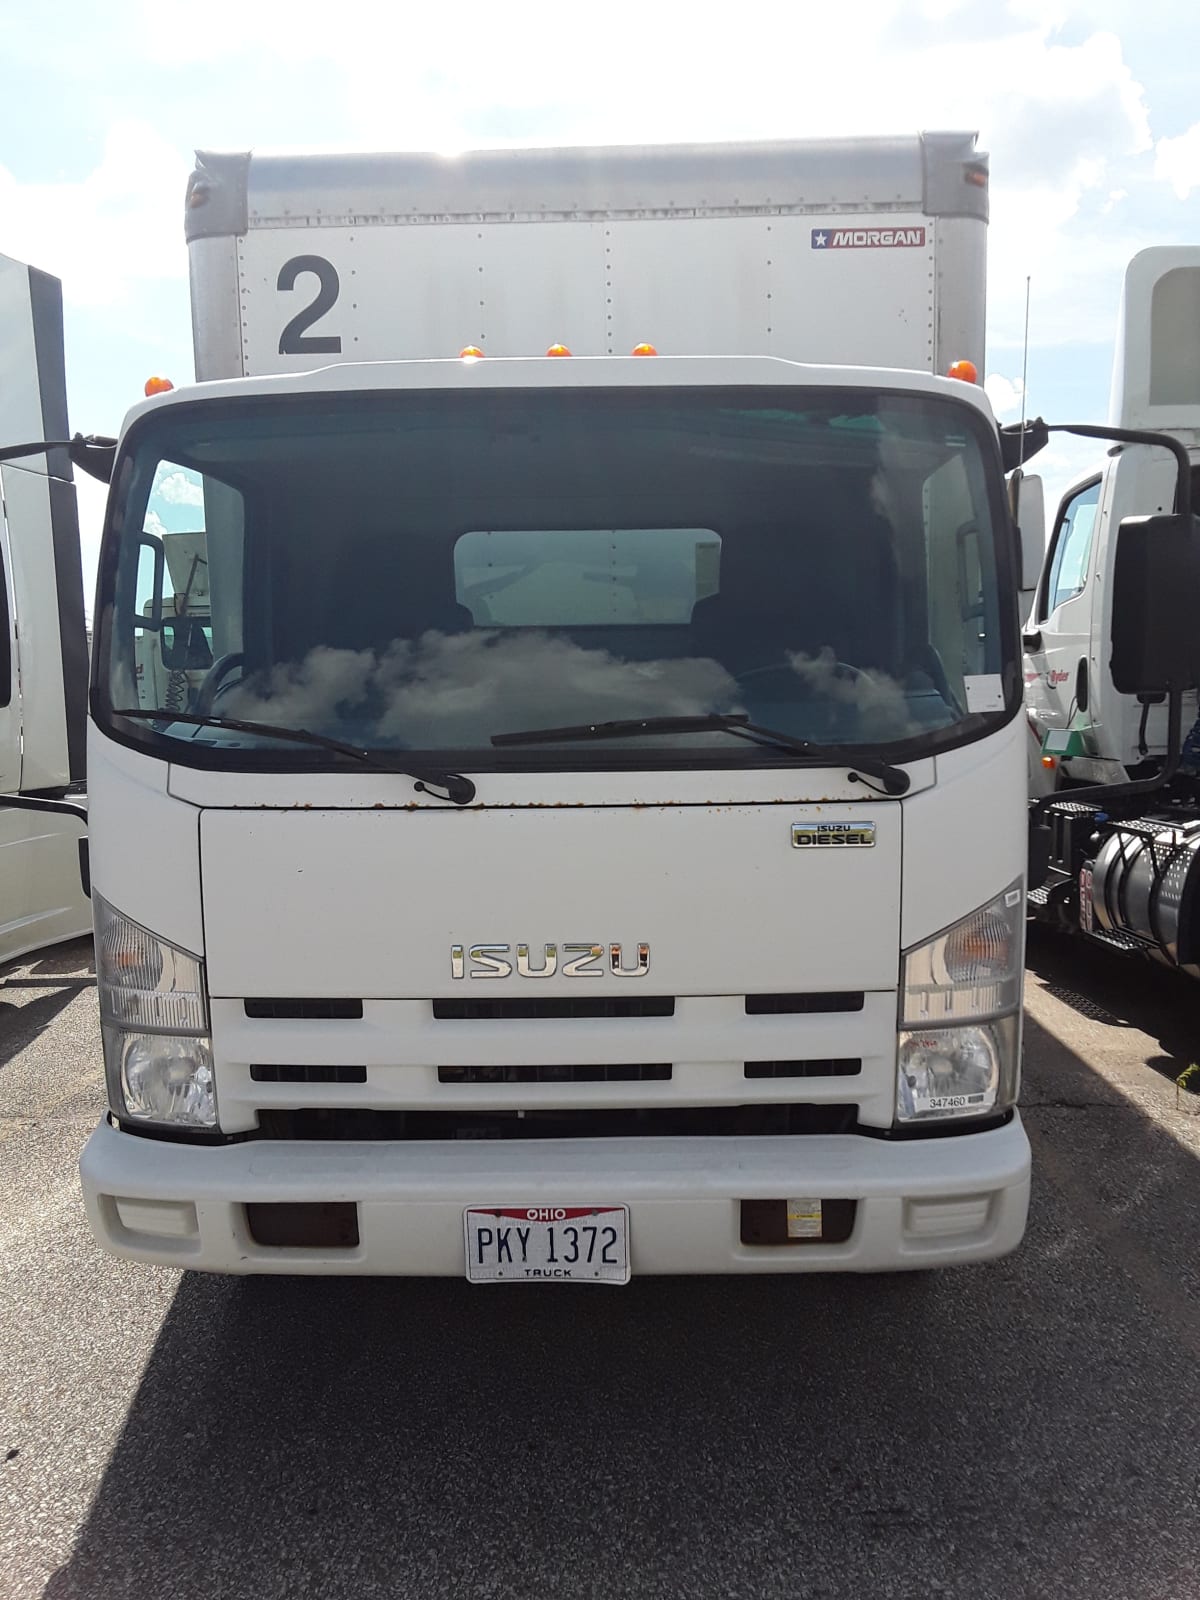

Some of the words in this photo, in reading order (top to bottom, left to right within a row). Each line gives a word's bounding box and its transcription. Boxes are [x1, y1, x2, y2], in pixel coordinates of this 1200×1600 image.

[833, 230, 921, 246] MORGAN
[277, 255, 341, 354] 2
[797, 834, 872, 845] DIESEL
[451, 943, 650, 979] ISUZU
[929, 1096, 966, 1108] 347460
[526, 1208, 567, 1220] OHIO
[477, 1227, 530, 1264] PKY
[547, 1226, 618, 1264] 1372
[524, 1269, 572, 1277] TRUCK
